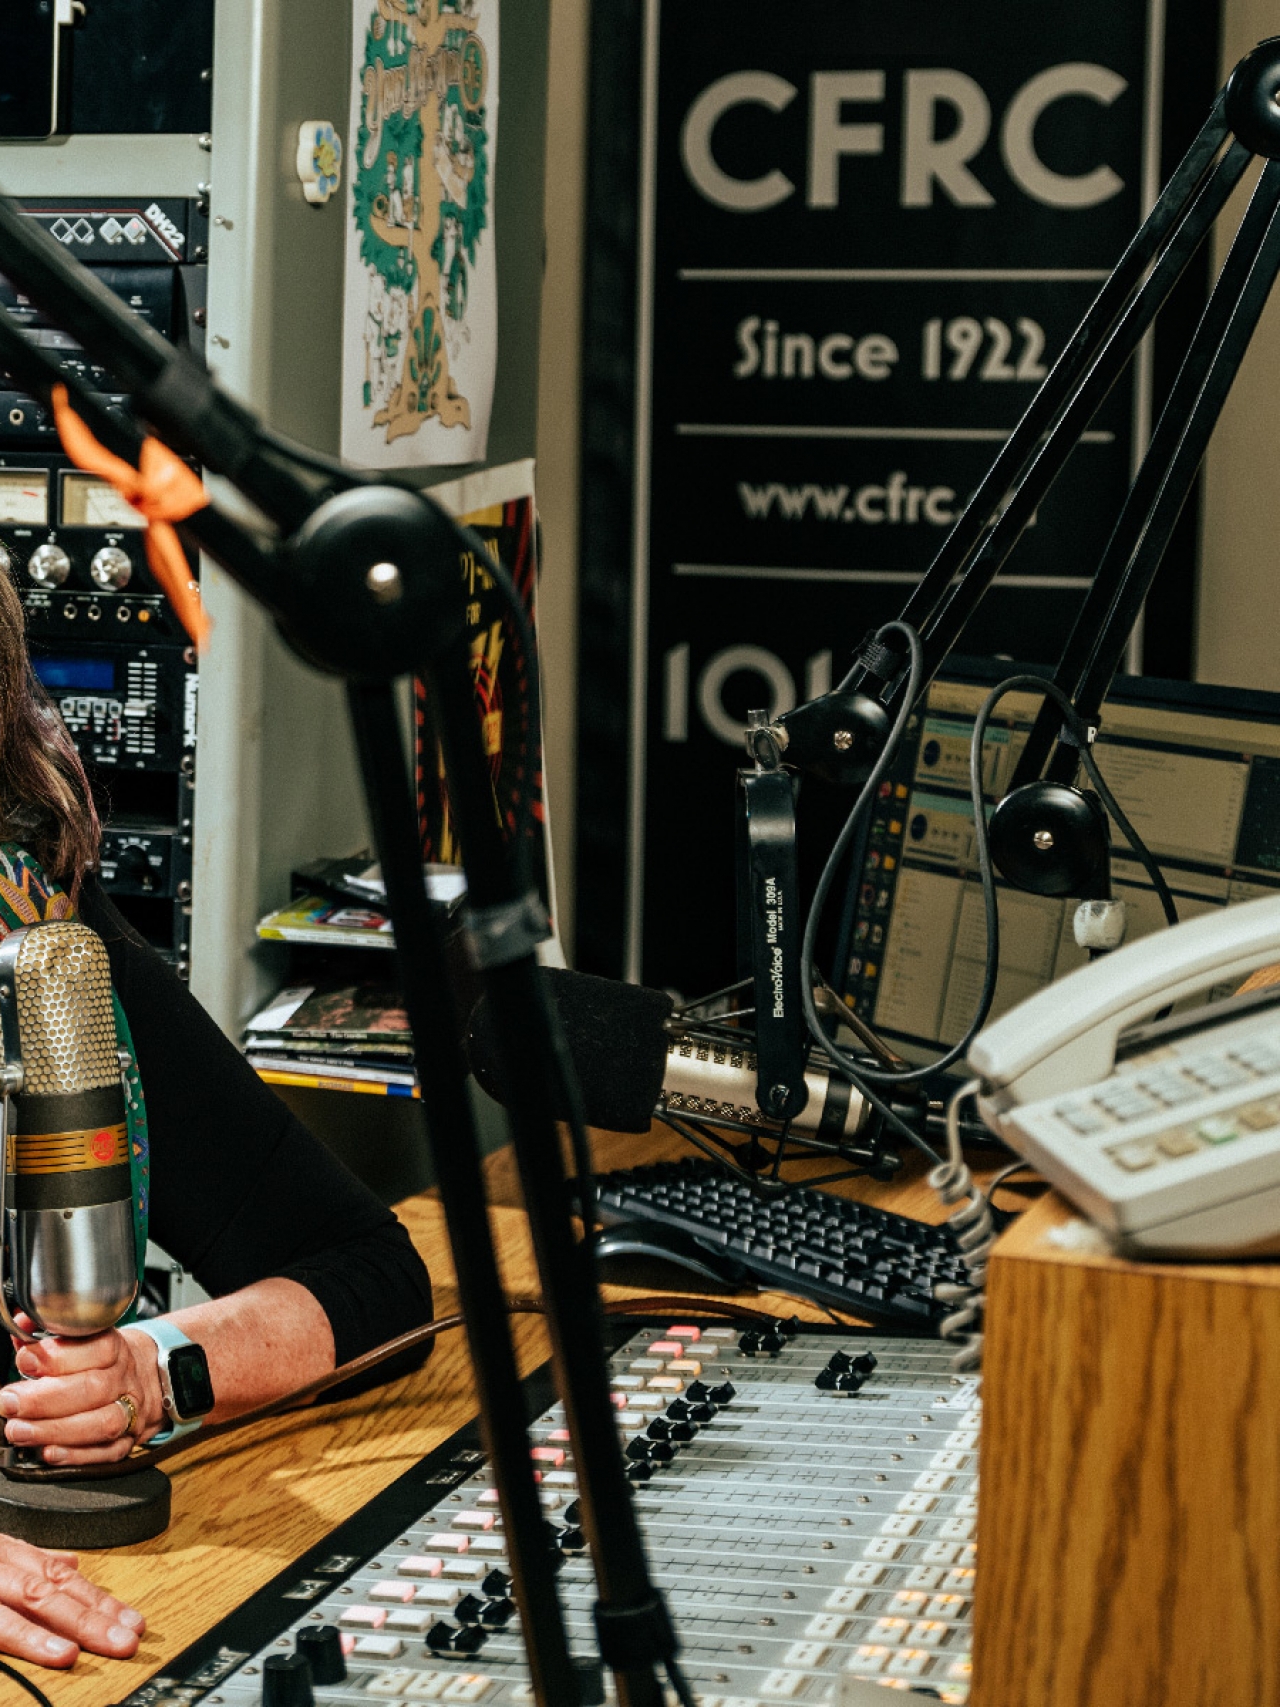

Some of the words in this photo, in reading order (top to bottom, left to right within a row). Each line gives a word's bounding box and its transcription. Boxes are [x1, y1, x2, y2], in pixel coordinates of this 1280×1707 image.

[681, 61, 1127, 211] CFRC
[735, 316, 899, 380] Since
[922, 315, 1048, 382] 1922
[739, 470, 1038, 527] www.cfrc.
[183, 673, 199, 747] Numark
[765, 877, 777, 905] 309A
[766, 910, 778, 943] Model
